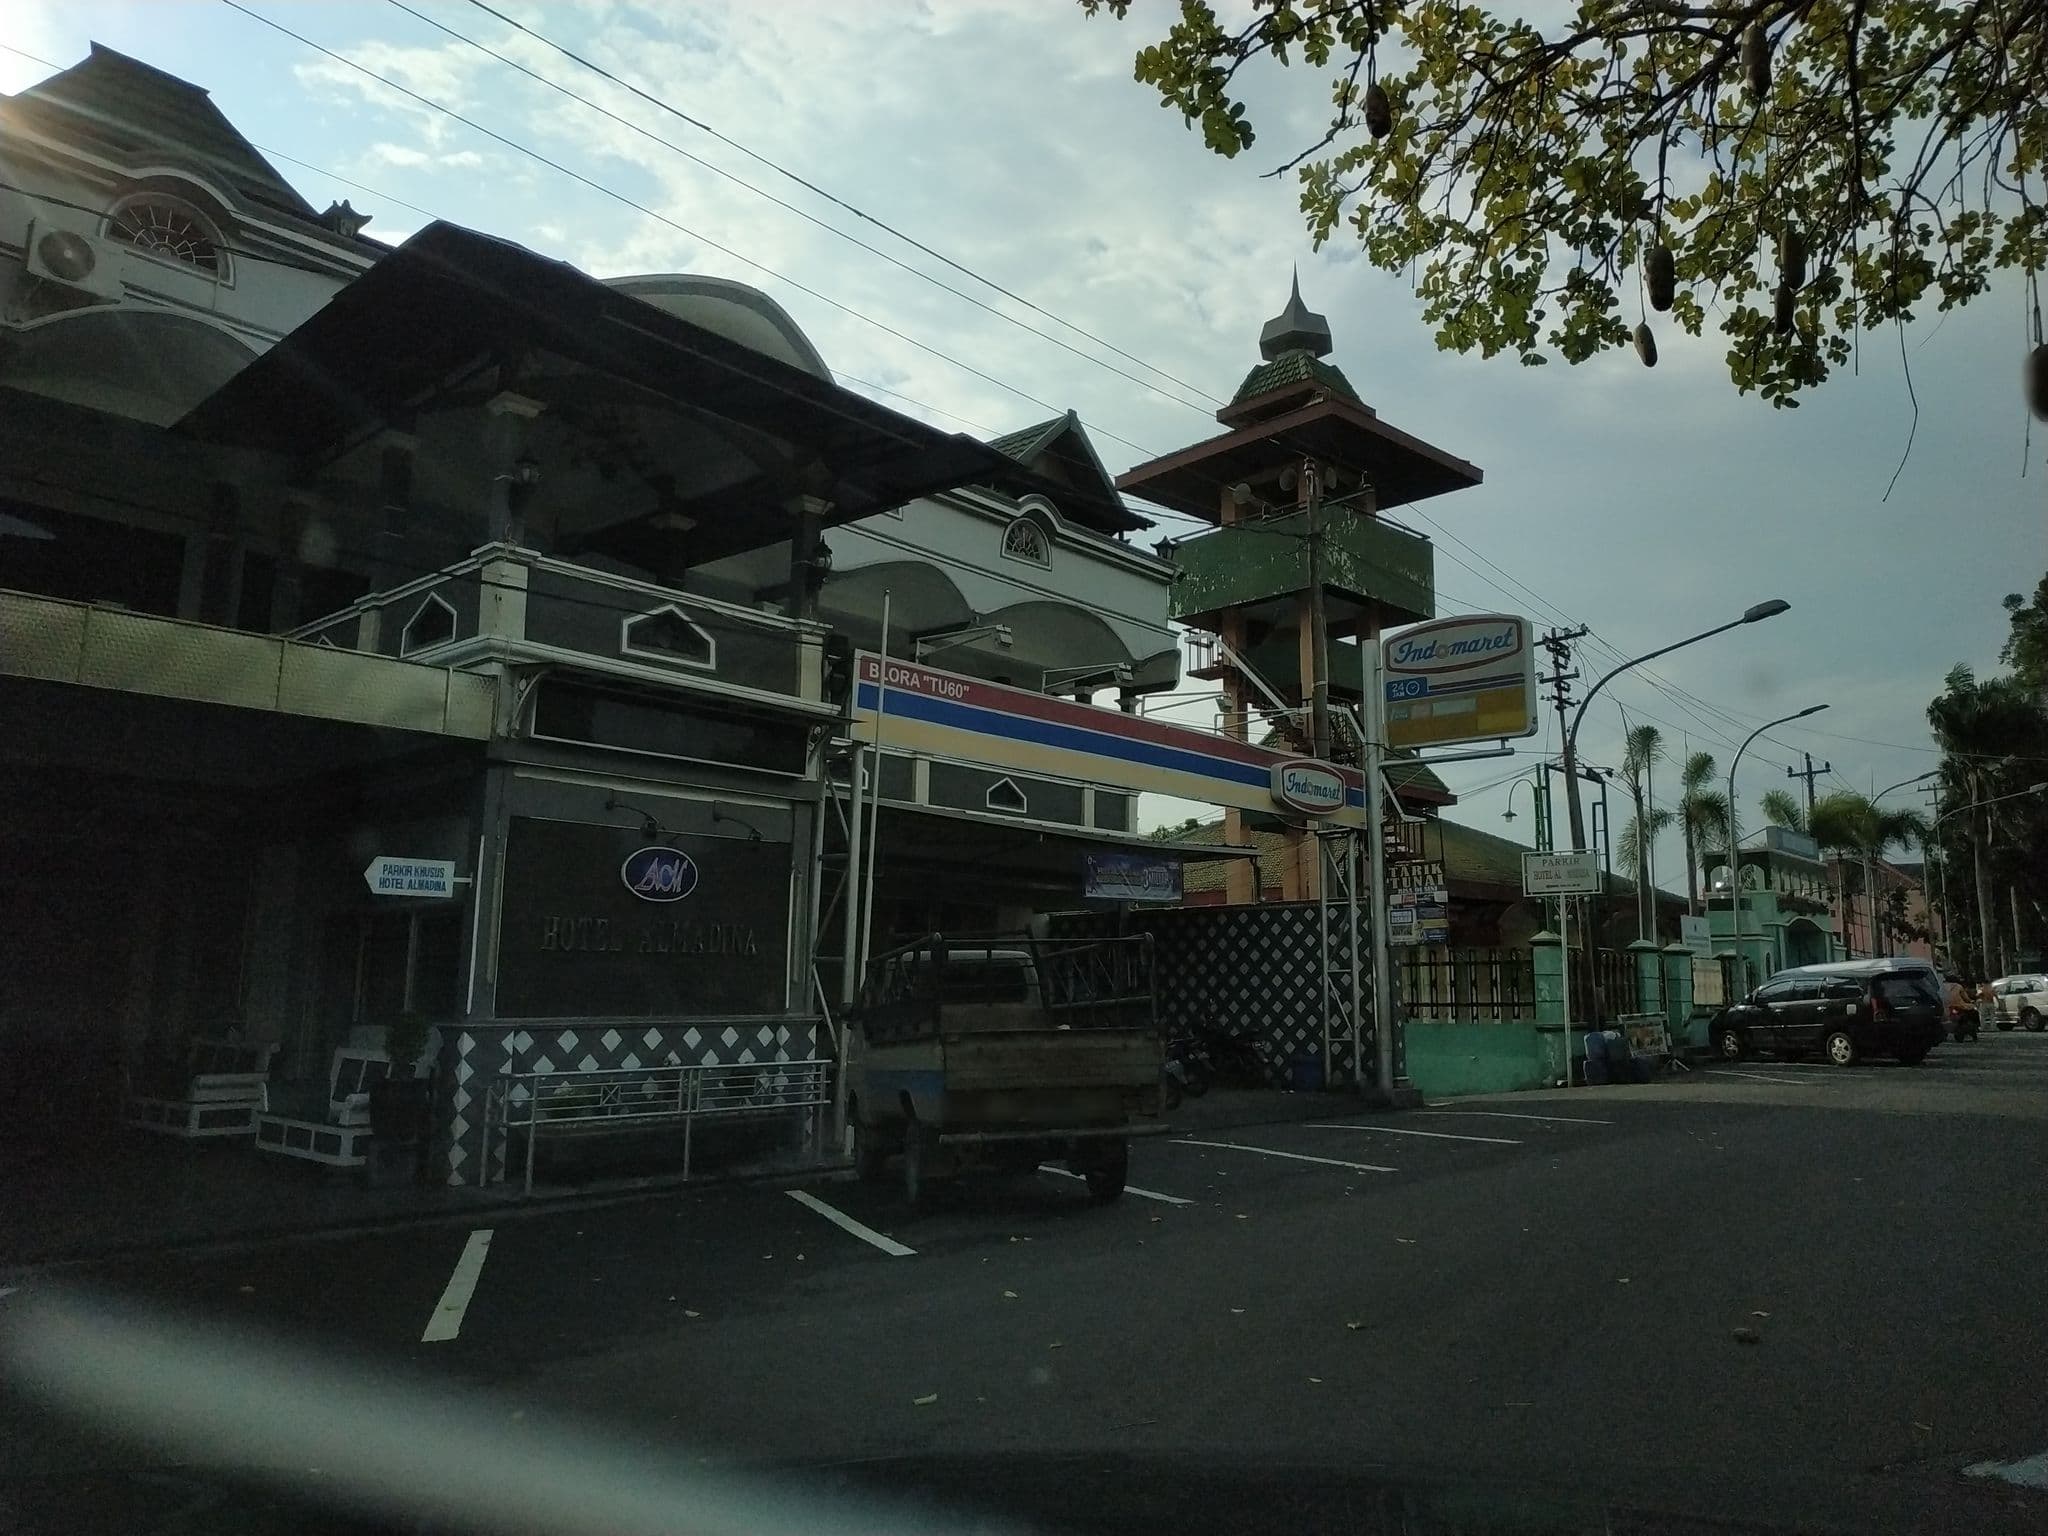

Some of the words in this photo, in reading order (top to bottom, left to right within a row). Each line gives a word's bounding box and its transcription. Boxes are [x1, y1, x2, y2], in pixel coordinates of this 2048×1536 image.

[1394, 626, 1514, 664] Indomaret
[869, 662, 920, 689] BLORA
[923, 675, 970, 698] "TU60"
[1392, 681, 1405, 690] 24
[1286, 772, 1341, 800] Indomaret
[1543, 857, 1580, 867] PARKIR
[382, 864, 413, 877] PARKIR
[414, 865, 445, 878] KHUSUS
[1389, 863, 1443, 878] TARIK
[379, 877, 403, 889] HOTEL
[407, 879, 446, 892] ALMADINA
[1391, 873, 1445, 889] TUNAI
[539, 915, 622, 952] HOTEL
